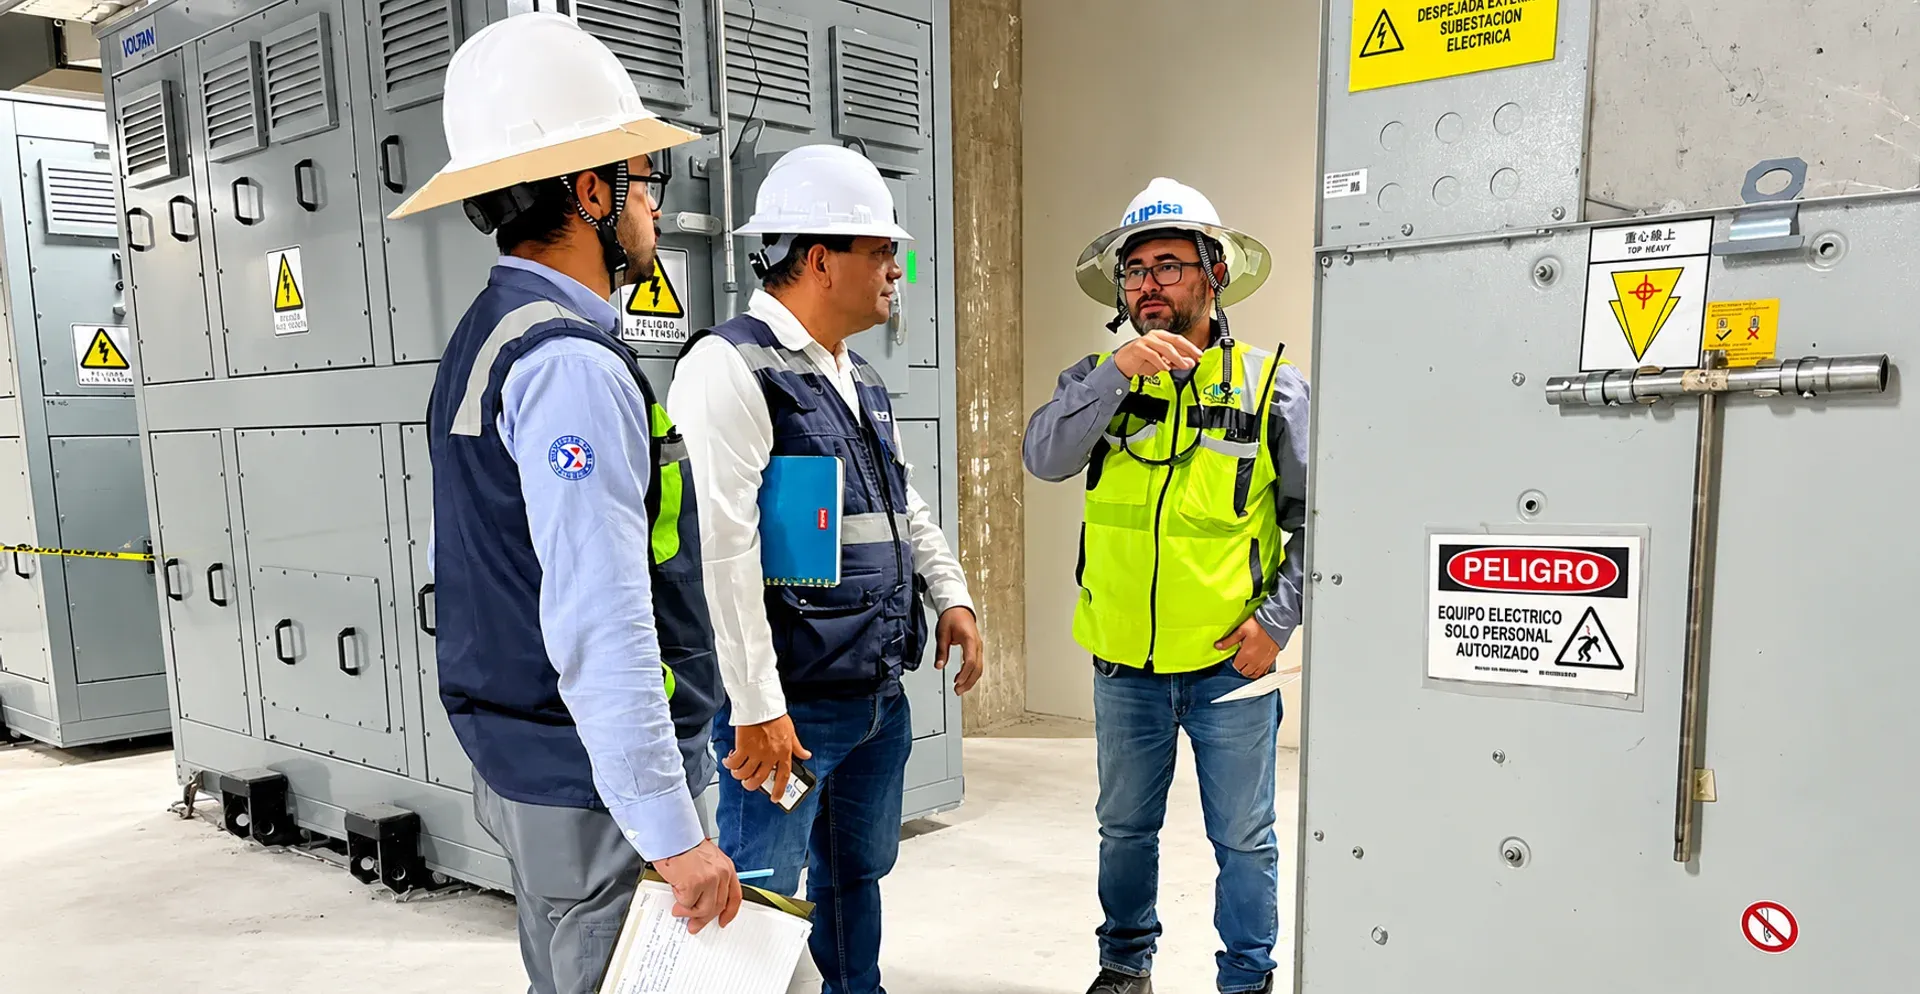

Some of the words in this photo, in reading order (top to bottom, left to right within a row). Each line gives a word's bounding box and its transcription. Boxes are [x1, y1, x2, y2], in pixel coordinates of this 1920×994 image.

[1417, 0, 1484, 22] DESPEJADA
[1440, 8, 1522, 35] SUBESTACION
[1447, 28, 1511, 52] ELECTRICA
[1628, 245, 1643, 254] TOP
[1645, 243, 1672, 254] HEAVY
[625, 327, 646, 337] ALTA
[636, 318, 675, 329] PELIGRO
[1463, 557, 1600, 585] PELIGRO
[1438, 605, 1485, 622] EQUIPO
[1488, 607, 1562, 625] ELECTRICO
[1444, 623, 1479, 639] SOLO
[1482, 626, 1553, 643] PERSONAL
[1456, 642, 1539, 661] AUTORIZADO
